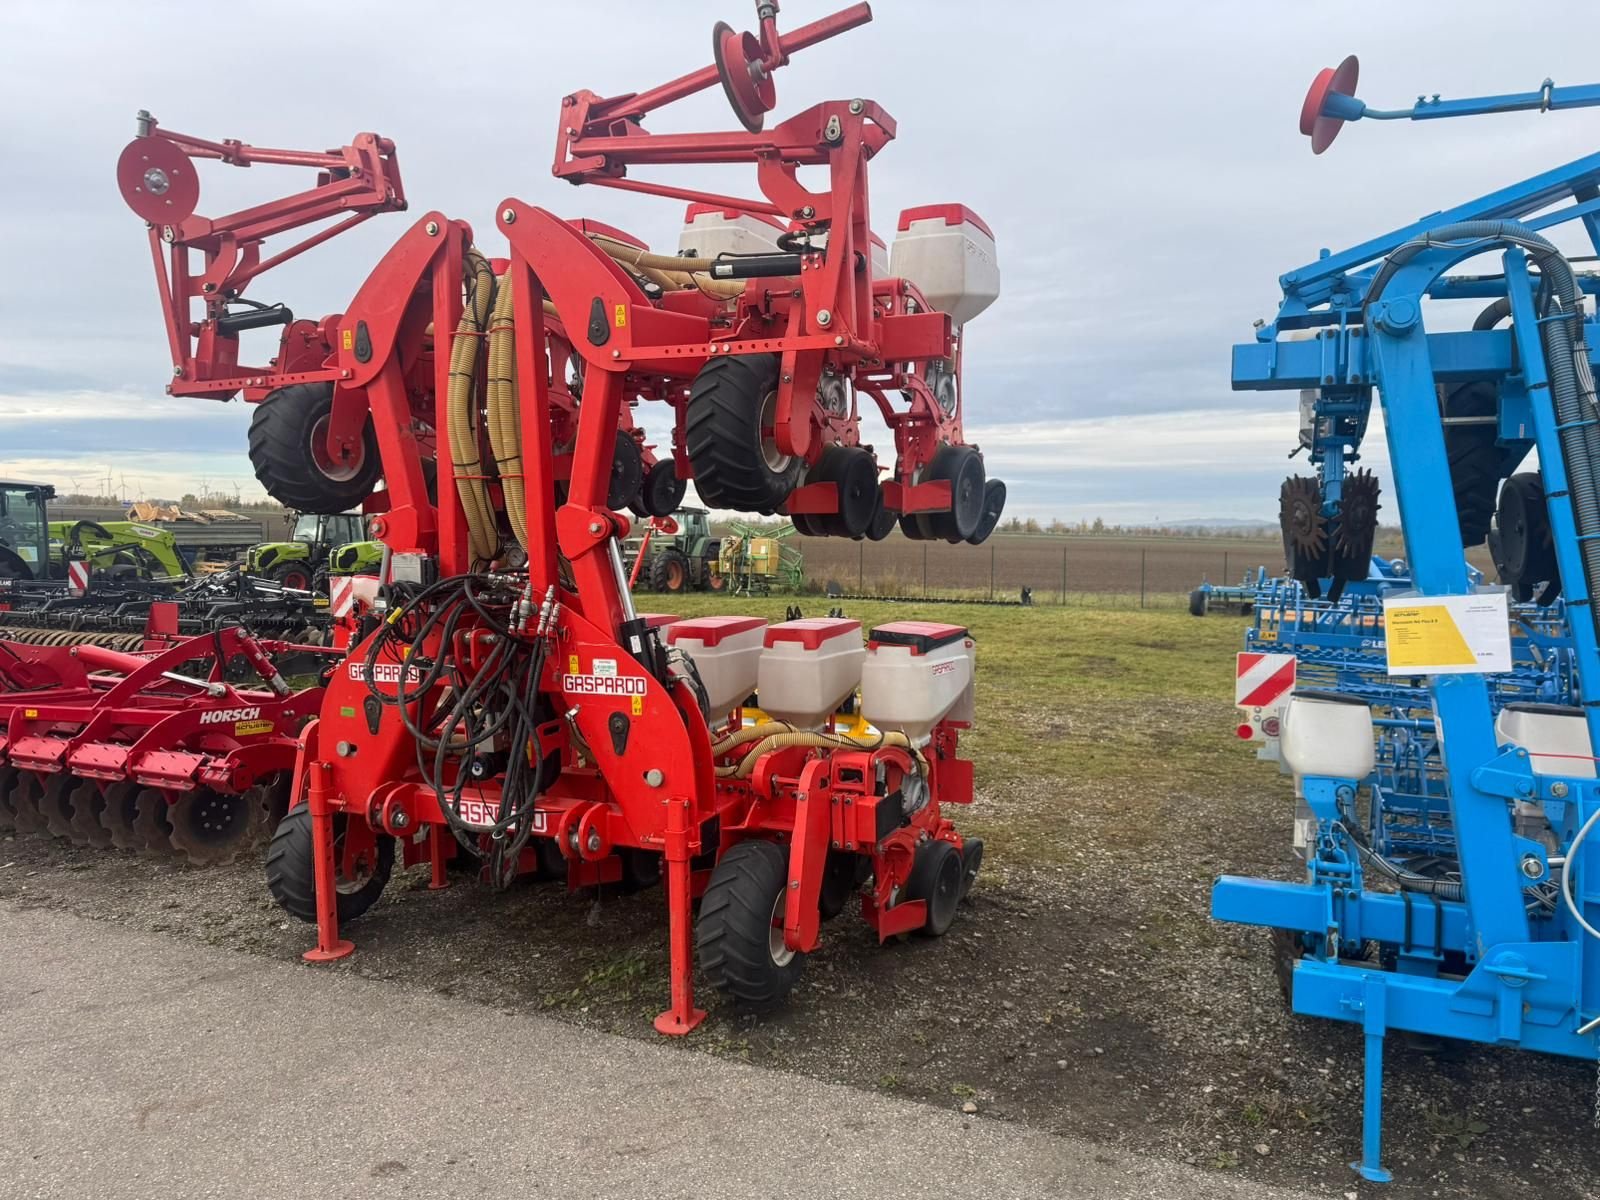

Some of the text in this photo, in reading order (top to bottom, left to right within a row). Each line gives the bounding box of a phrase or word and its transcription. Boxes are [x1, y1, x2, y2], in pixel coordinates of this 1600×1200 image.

[350, 664, 419, 681] GAPARO
[564, 675, 645, 694] GASPARDO
[199, 707, 260, 724] HORSCH
